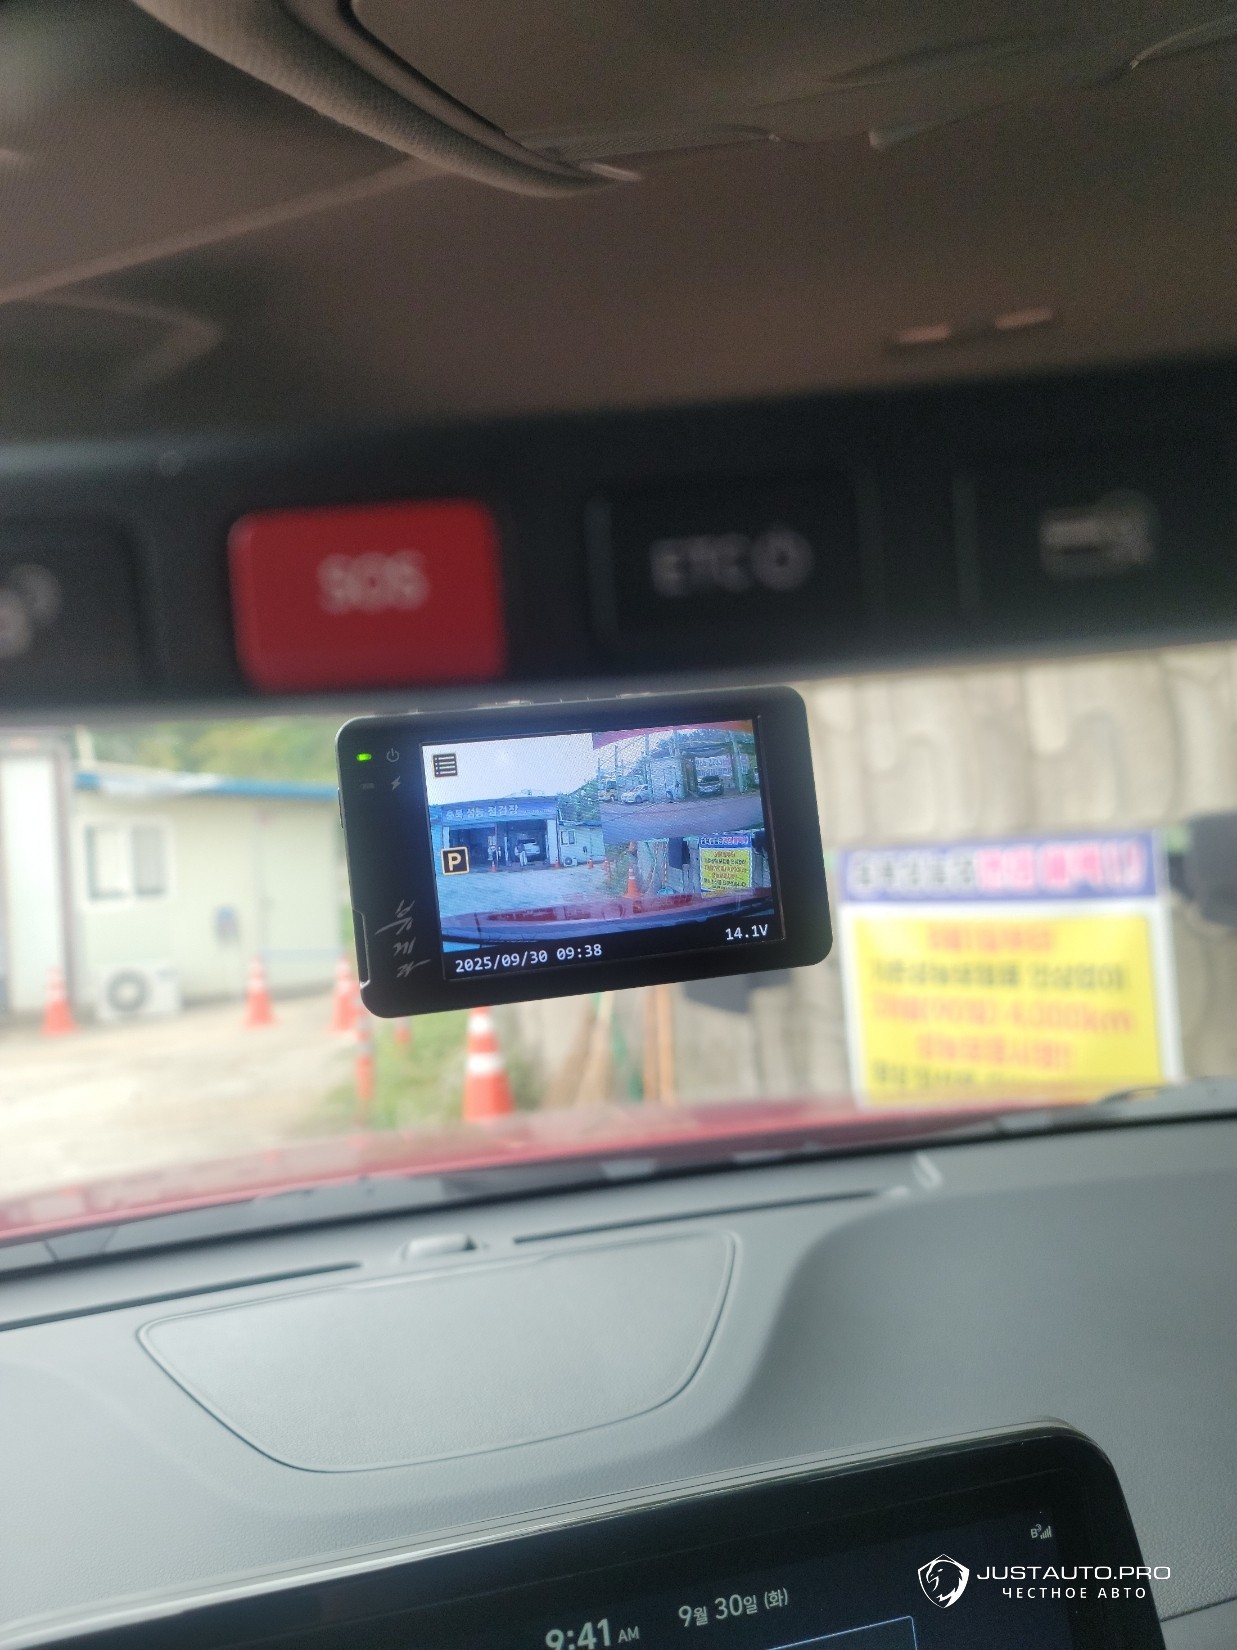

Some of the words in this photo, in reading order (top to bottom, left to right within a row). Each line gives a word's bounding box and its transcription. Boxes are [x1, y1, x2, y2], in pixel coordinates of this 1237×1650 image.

[318, 549, 430, 614] SOS
[725, 924, 769, 940] 14.1V
[455, 950, 548, 973] 2025/09/30
[556, 943, 603, 960] 09:38
[678, 1605, 709, 1627] 9월
[714, 1594, 758, 1620] 30일
[764, 1587, 789, 1610] (화)
[545, 1618, 612, 1650] 9:41
[617, 1626, 640, 1643] AM
